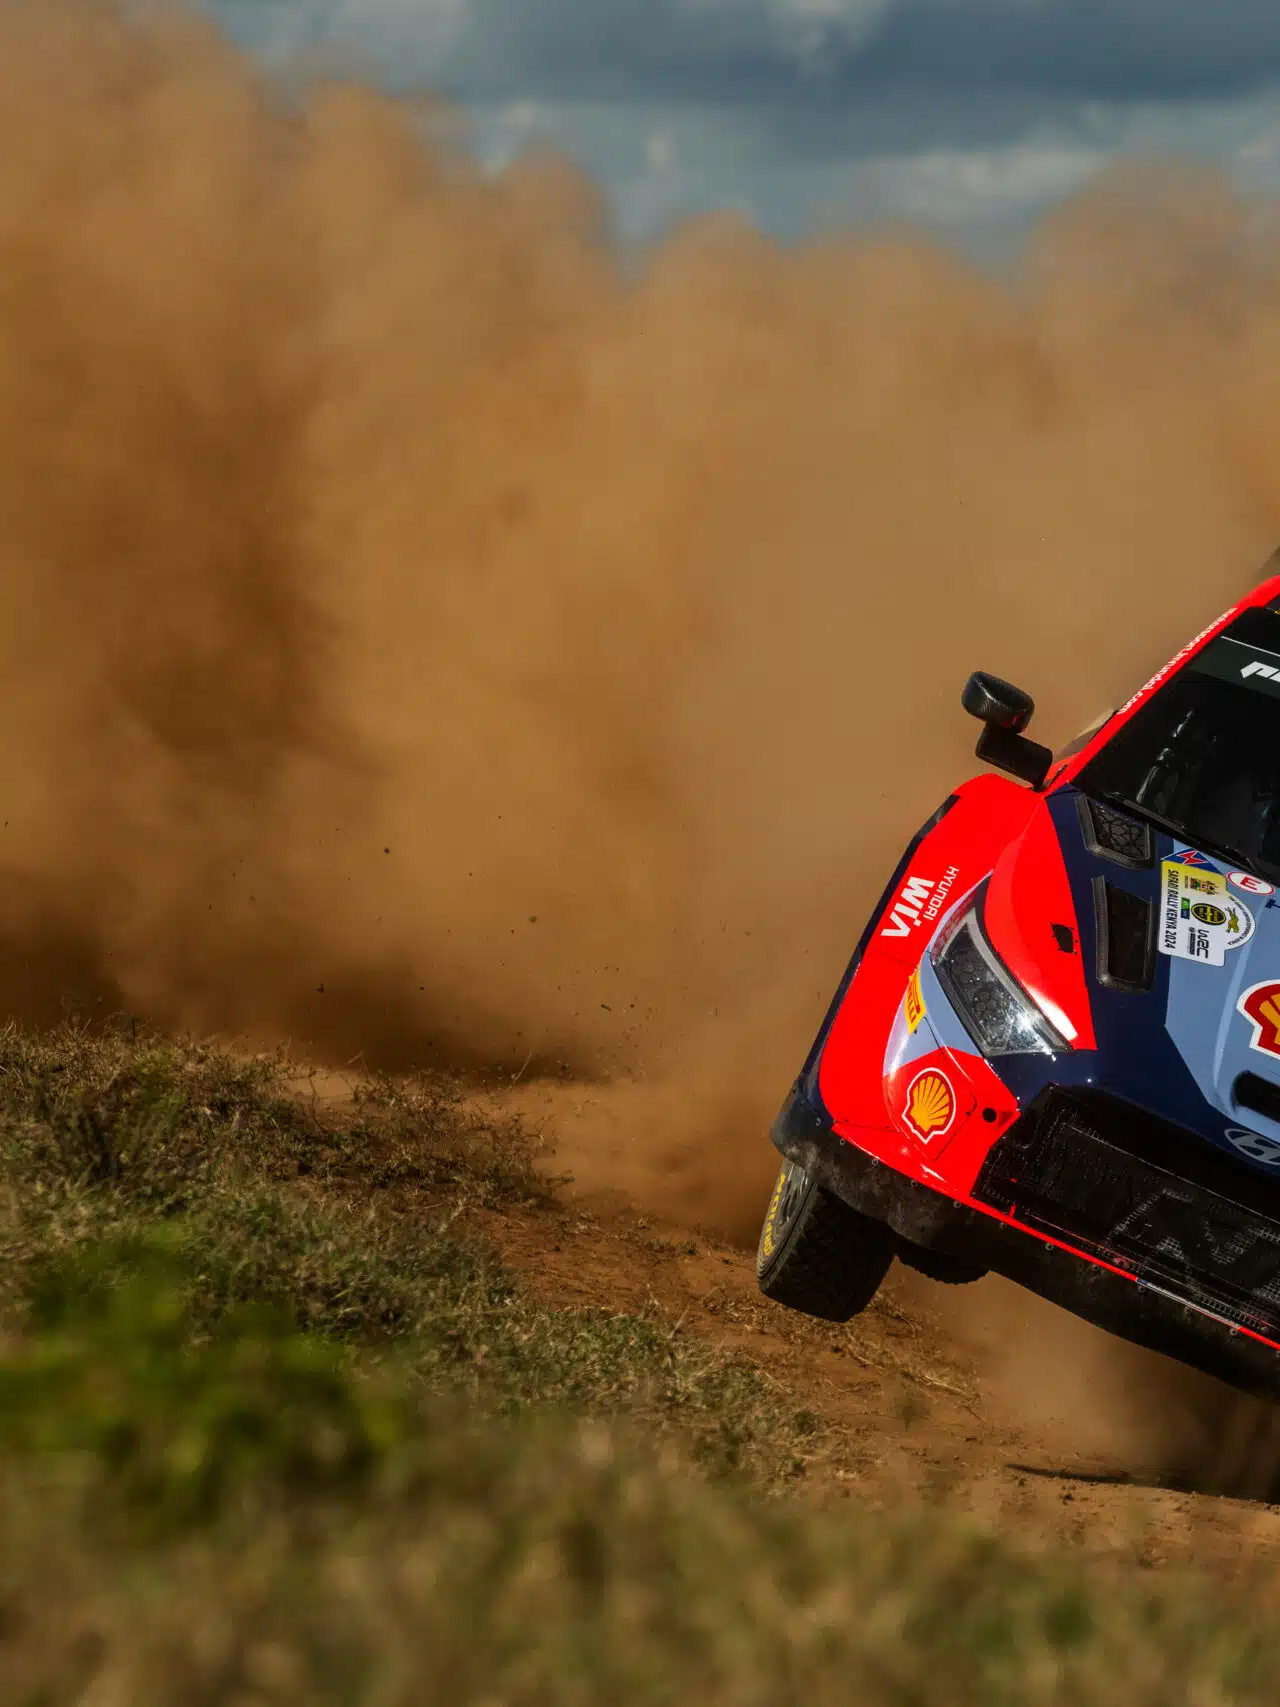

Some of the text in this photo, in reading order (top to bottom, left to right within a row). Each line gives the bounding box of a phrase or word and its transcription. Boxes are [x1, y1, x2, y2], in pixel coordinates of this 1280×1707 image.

[923, 866, 960, 921] HYUNDAI
[1240, 876, 1262, 892] E
[1164, 869, 1179, 949] SAFARI RALLY KENYA 2024
[1196, 929, 1210, 959] WRC
